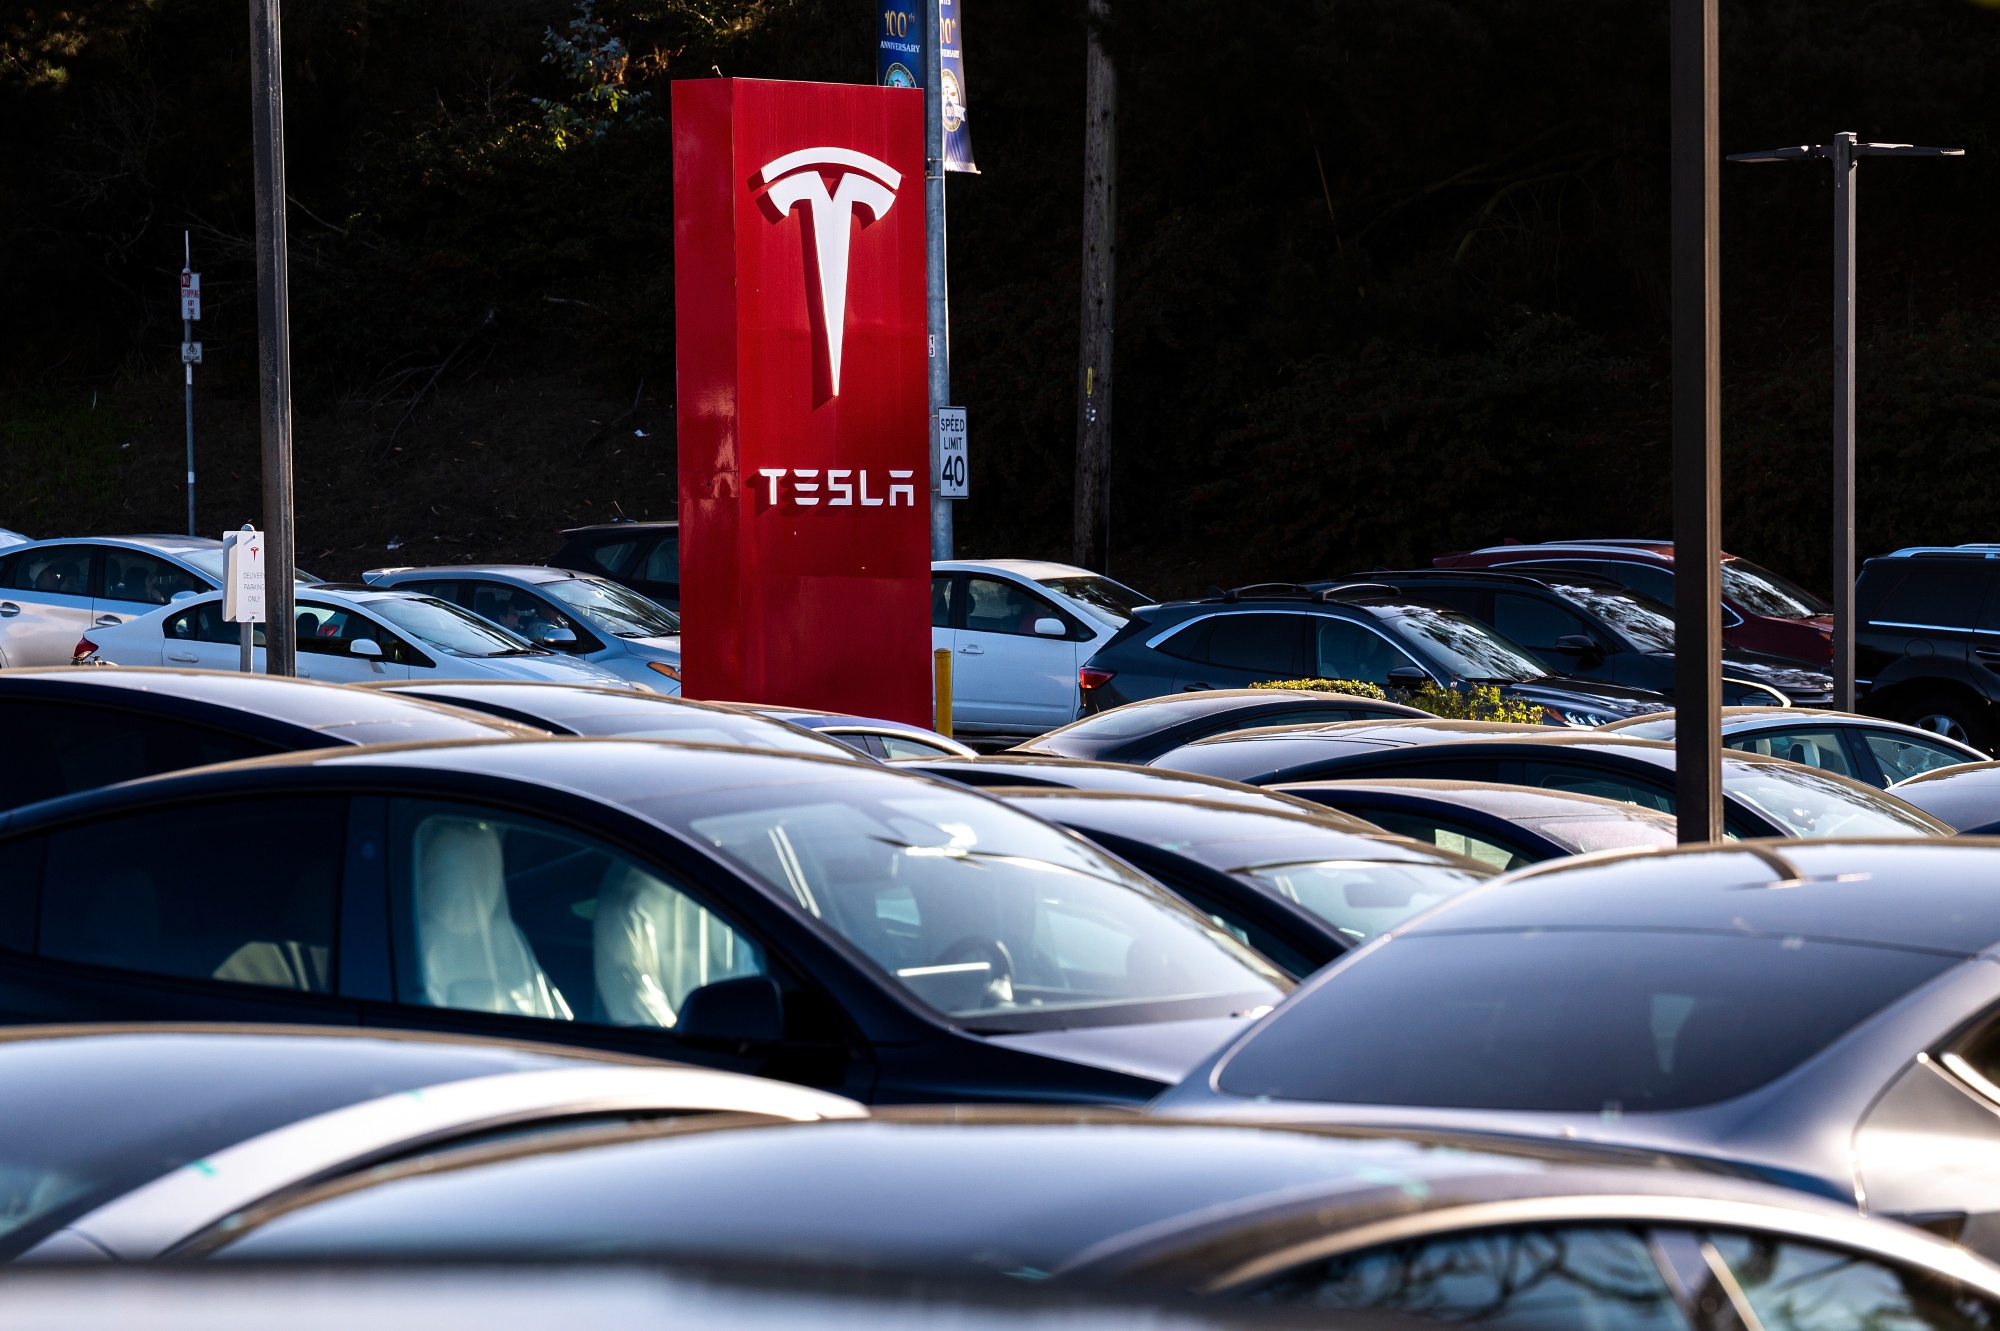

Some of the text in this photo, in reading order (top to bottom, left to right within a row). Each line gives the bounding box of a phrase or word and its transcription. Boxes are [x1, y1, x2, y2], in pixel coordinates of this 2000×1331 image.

[880, 40, 921, 53] ANNIVERSARY
[183, 275, 189, 285] NO
[940, 418, 965, 432] SPEED
[943, 436, 963, 451] LIMIT
[942, 455, 965, 487] 40
[759, 468, 914, 506] TESLA
[243, 583, 265, 591] PARKING
[247, 595, 261, 603] ONLY
